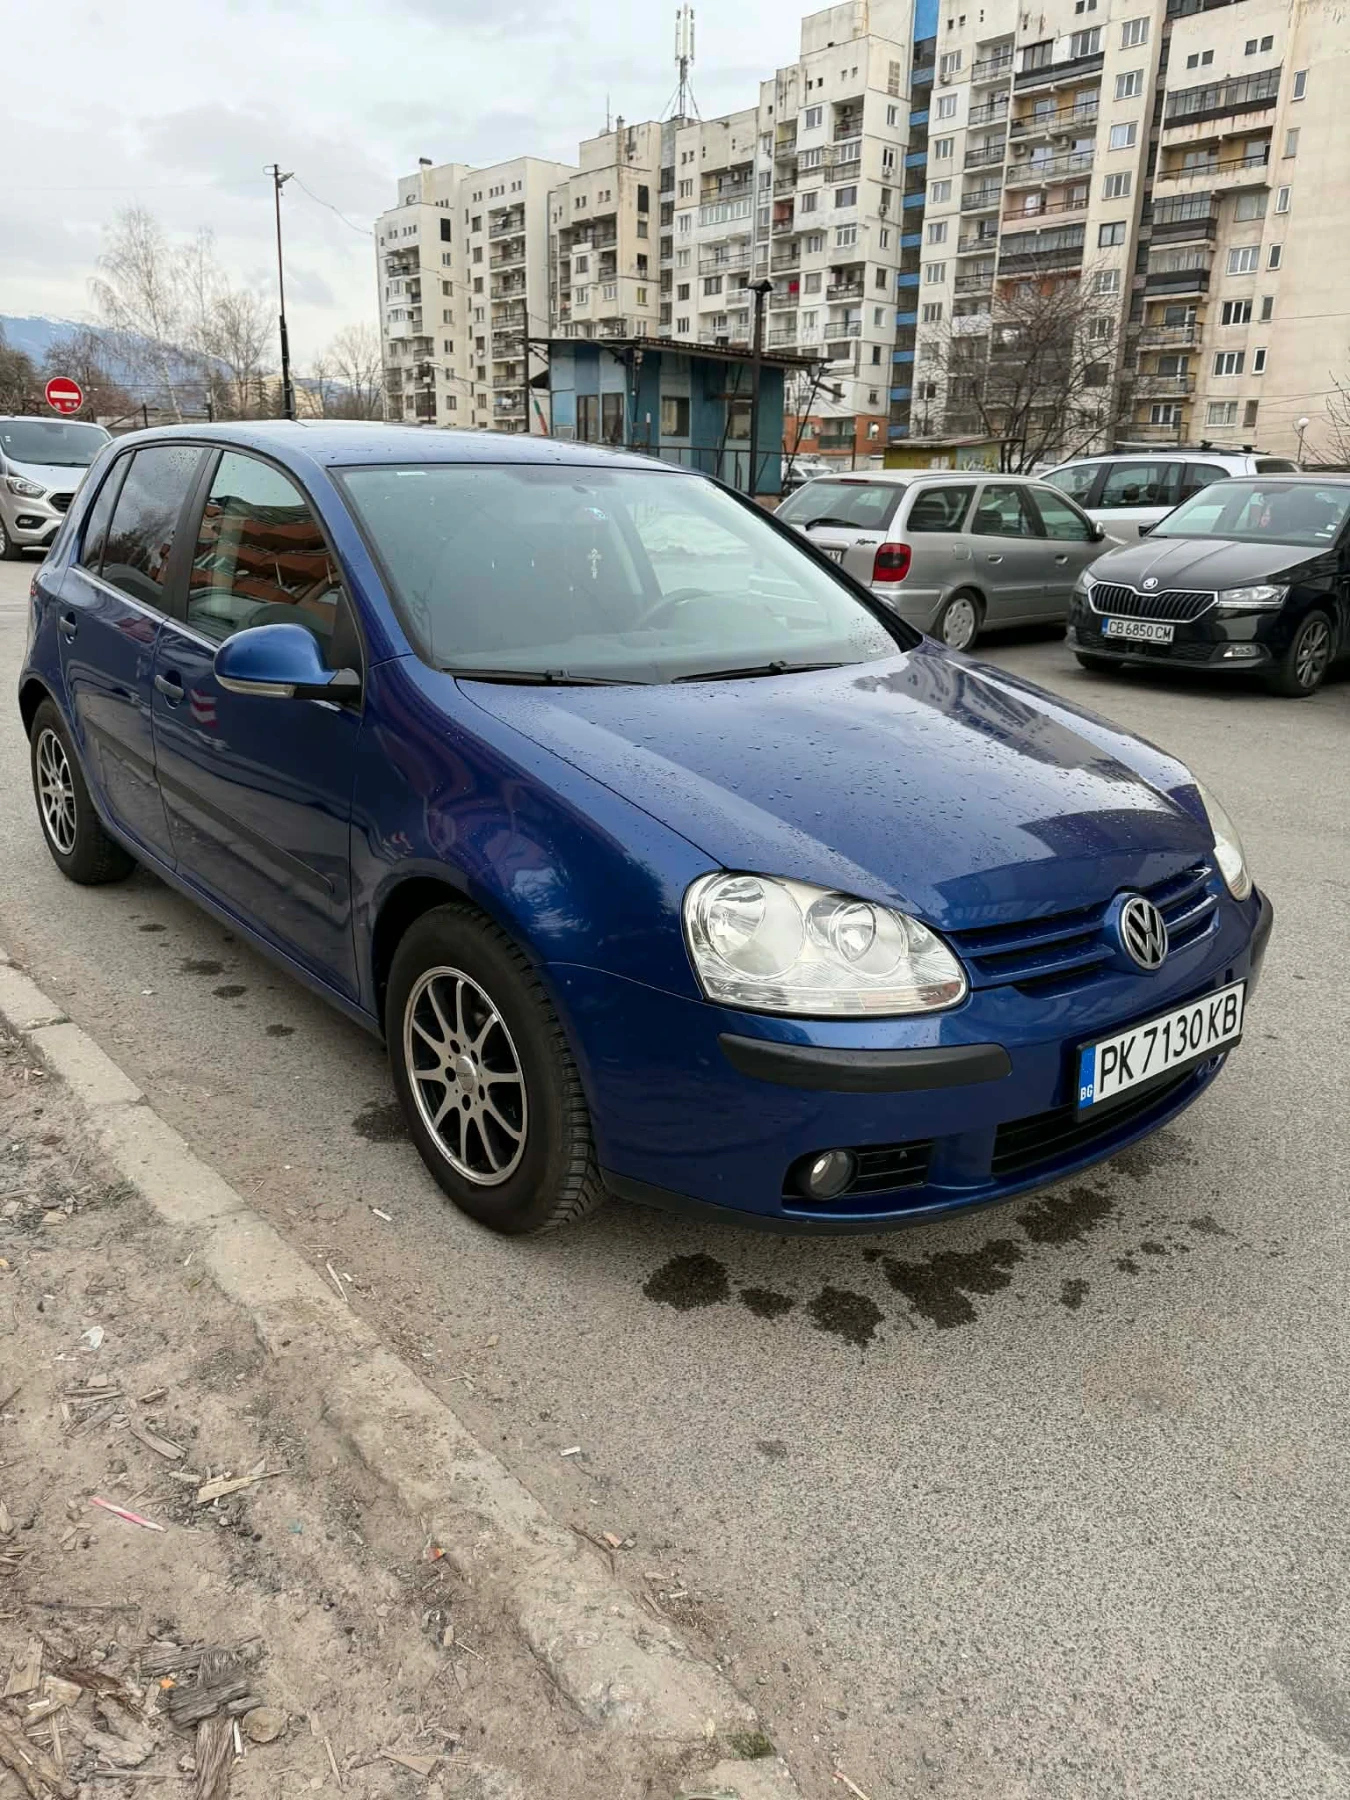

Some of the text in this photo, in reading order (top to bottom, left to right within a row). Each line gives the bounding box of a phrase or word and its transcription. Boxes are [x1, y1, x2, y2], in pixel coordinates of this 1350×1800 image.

[1109, 621, 1124, 634] CB
[1125, 623, 1154, 637] 6850
[1155, 626, 1172, 640] CM
[1122, 899, 1167, 968] VW
[1099, 994, 1237, 1092] PK 7130 KB
[1081, 1085, 1094, 1101] BG
